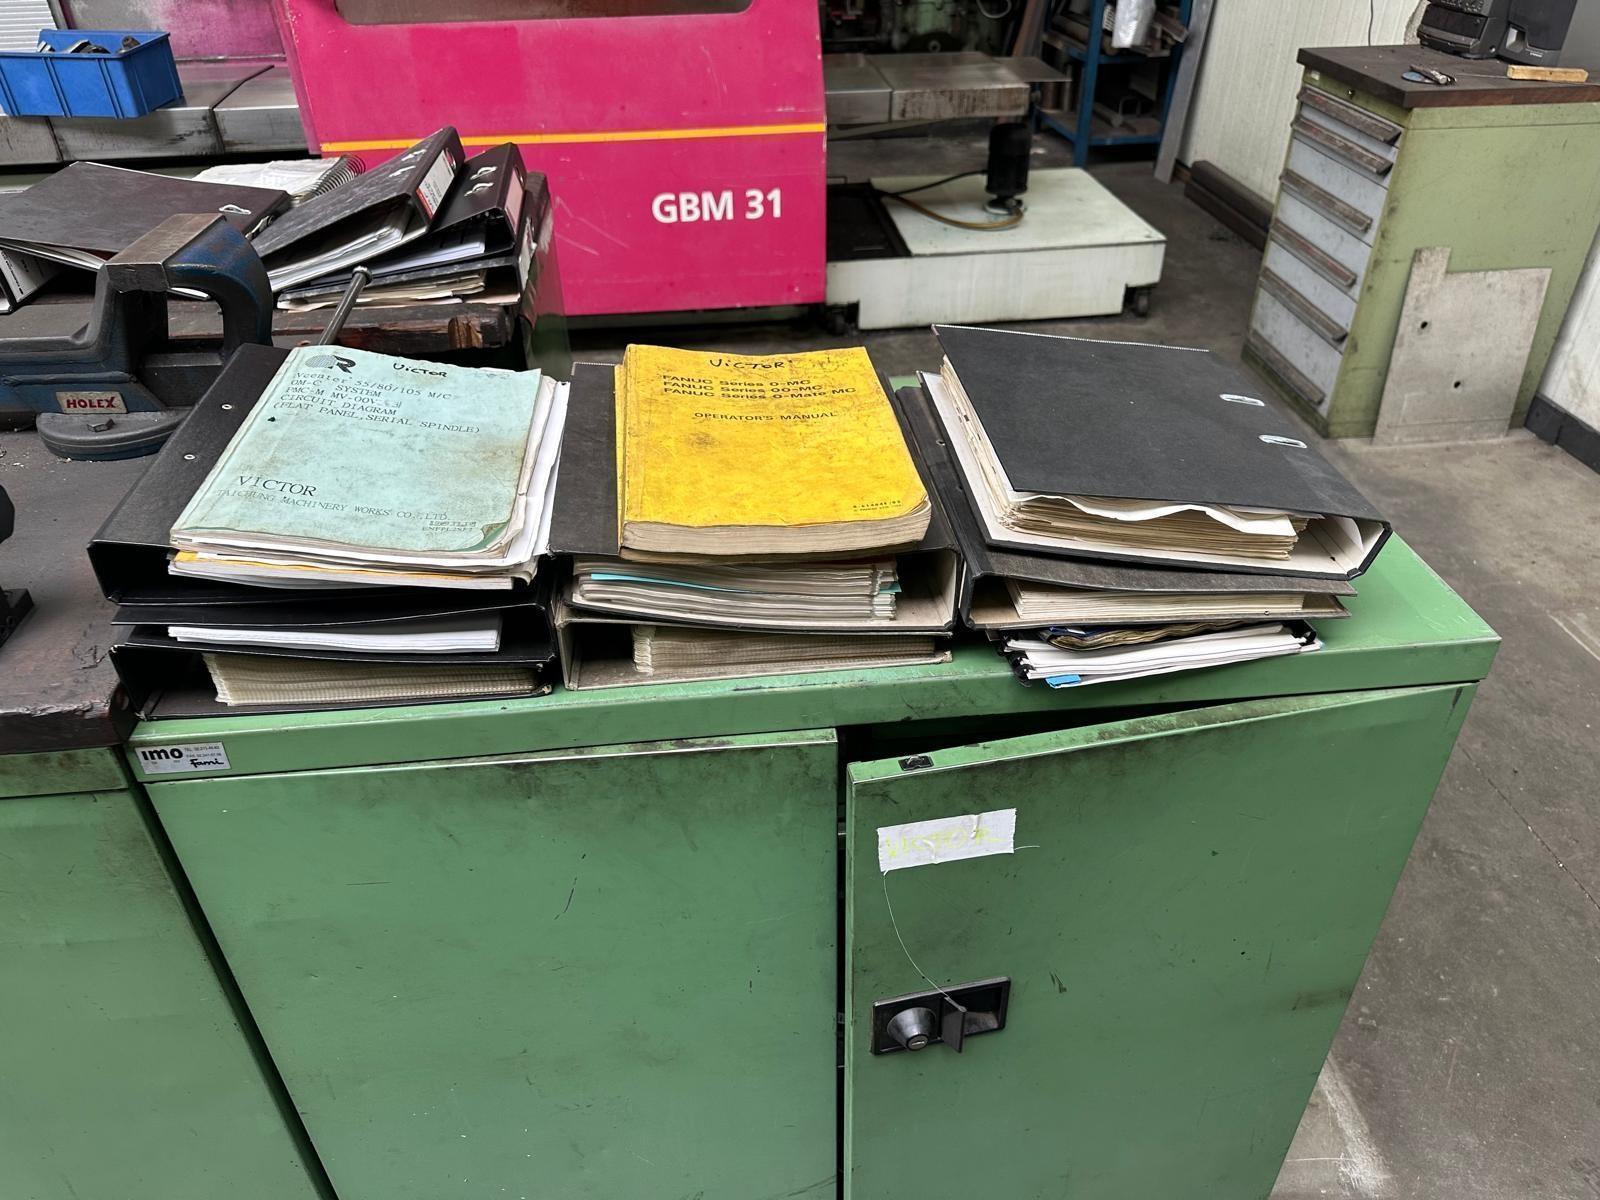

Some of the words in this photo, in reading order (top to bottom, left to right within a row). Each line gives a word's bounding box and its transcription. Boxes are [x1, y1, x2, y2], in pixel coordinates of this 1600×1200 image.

[652, 190, 734, 224] GBM
[745, 187, 782, 220] 31
[663, 375, 713, 384] FANUC
[663, 381, 714, 391] FANUC
[335, 384, 382, 398] SYSTEM
[428, 391, 452, 400] M/C
[664, 388, 715, 397] FANUC
[66, 396, 116, 409] HOLEX
[280, 394, 336, 406] CIRCUIT
[342, 401, 397, 416] DIAGRAM
[694, 412, 774, 421] OPERATOR'S
[780, 412, 838, 421] MANUAL
[420, 421, 480, 434] SPINDLE)
[240, 475, 317, 497] VICTOR
[216, 489, 275, 502] TAICHUNG
[280, 496, 349, 511] MACHINERY
[354, 505, 392, 516] WORKS
